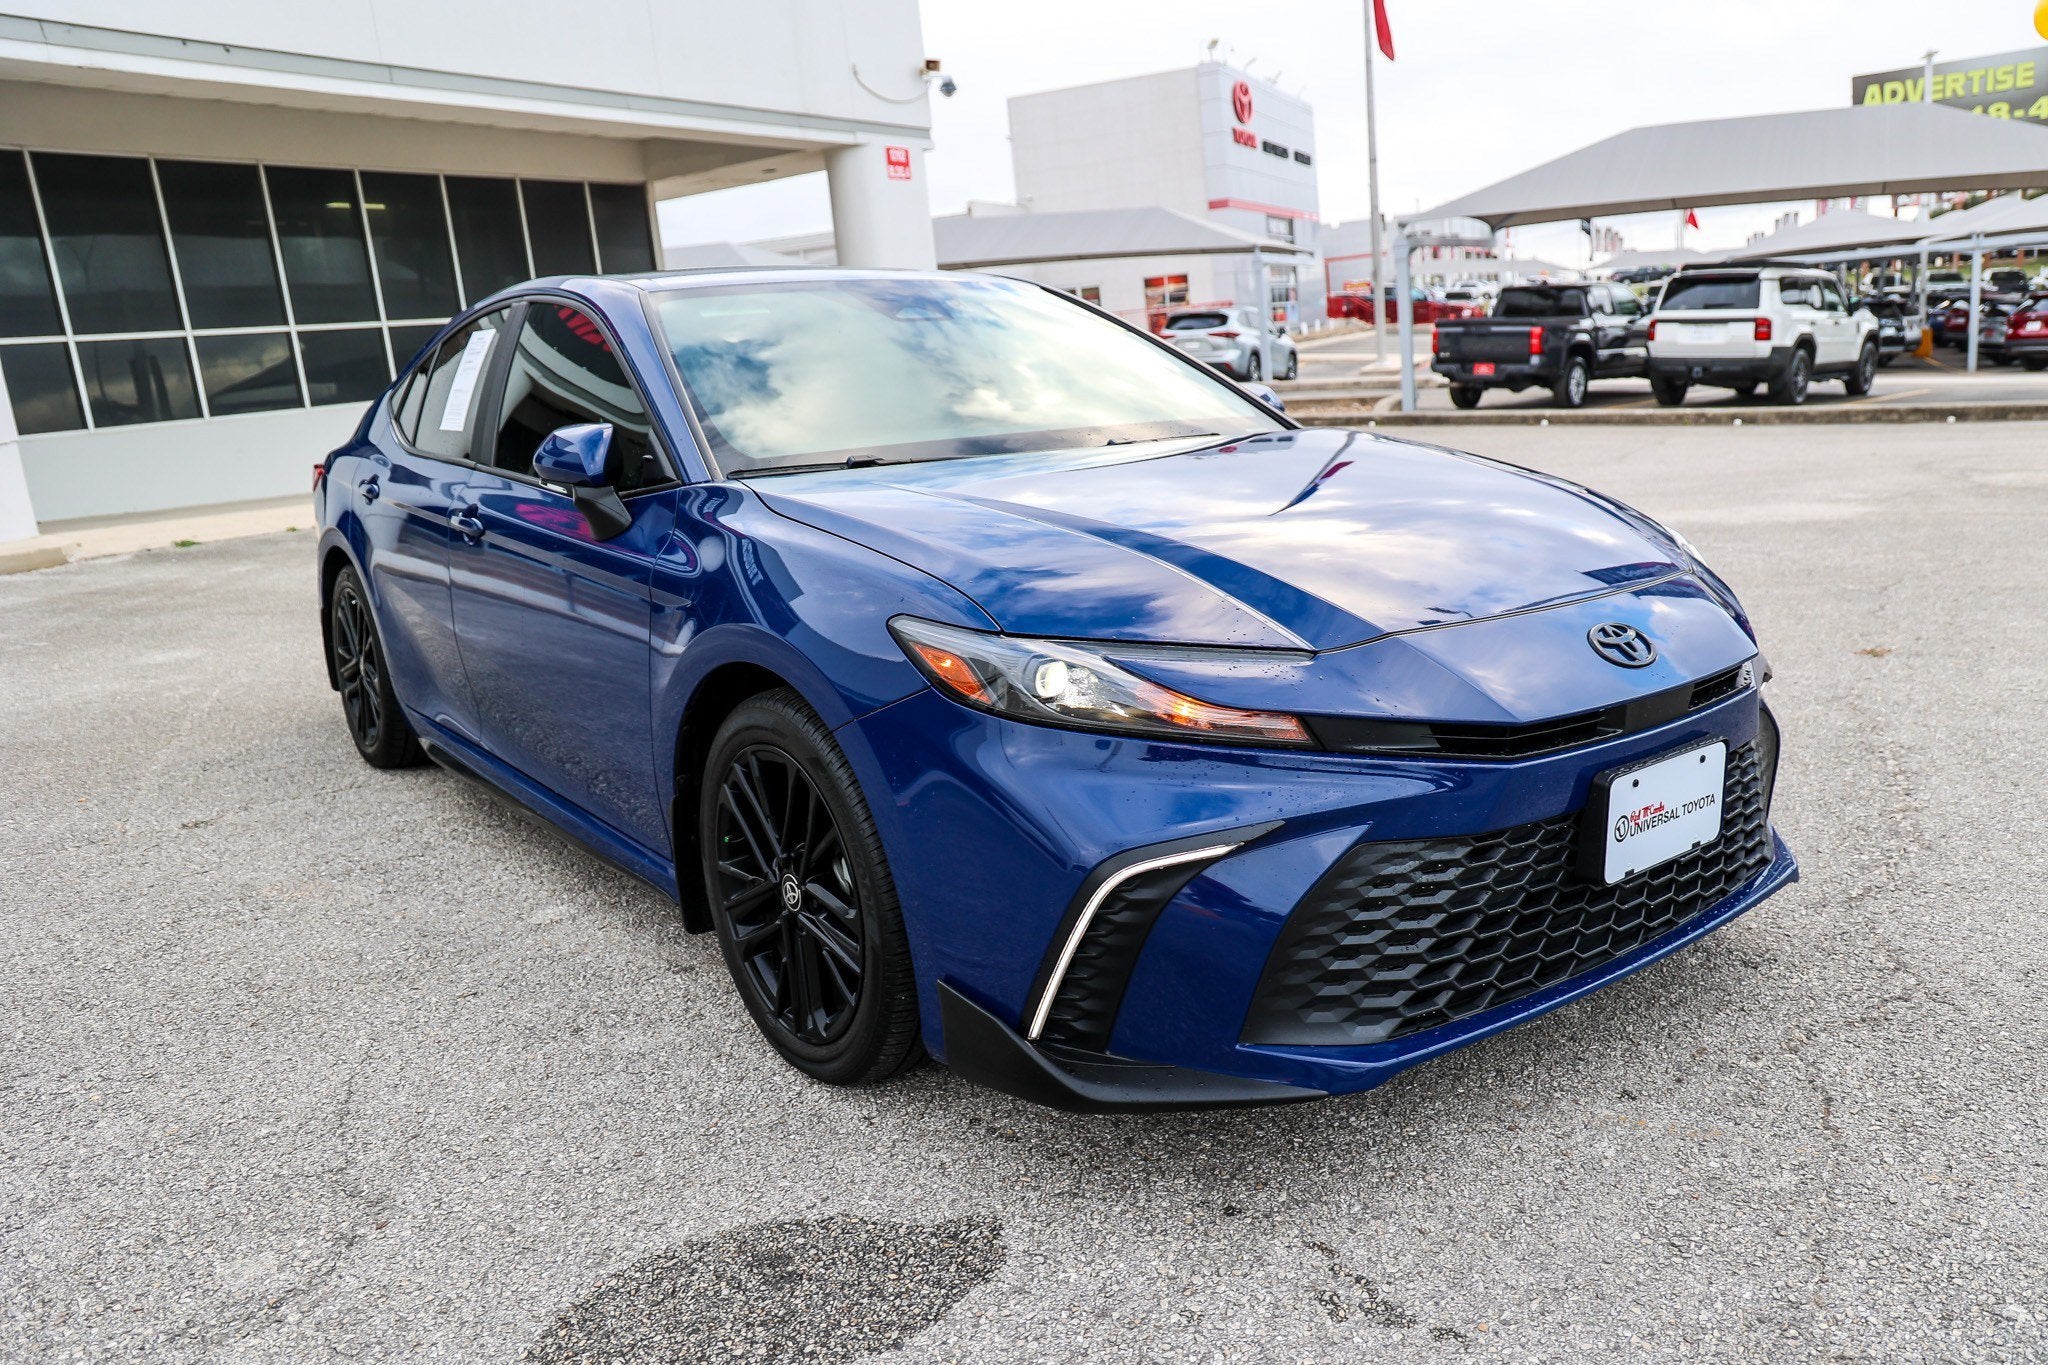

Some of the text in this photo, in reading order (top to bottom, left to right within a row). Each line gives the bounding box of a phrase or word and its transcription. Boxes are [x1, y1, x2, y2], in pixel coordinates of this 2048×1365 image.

[1863, 62, 2035, 105] ADVERTISE
[1630, 794, 1716, 837] UNIVERSAL TOYOTA
